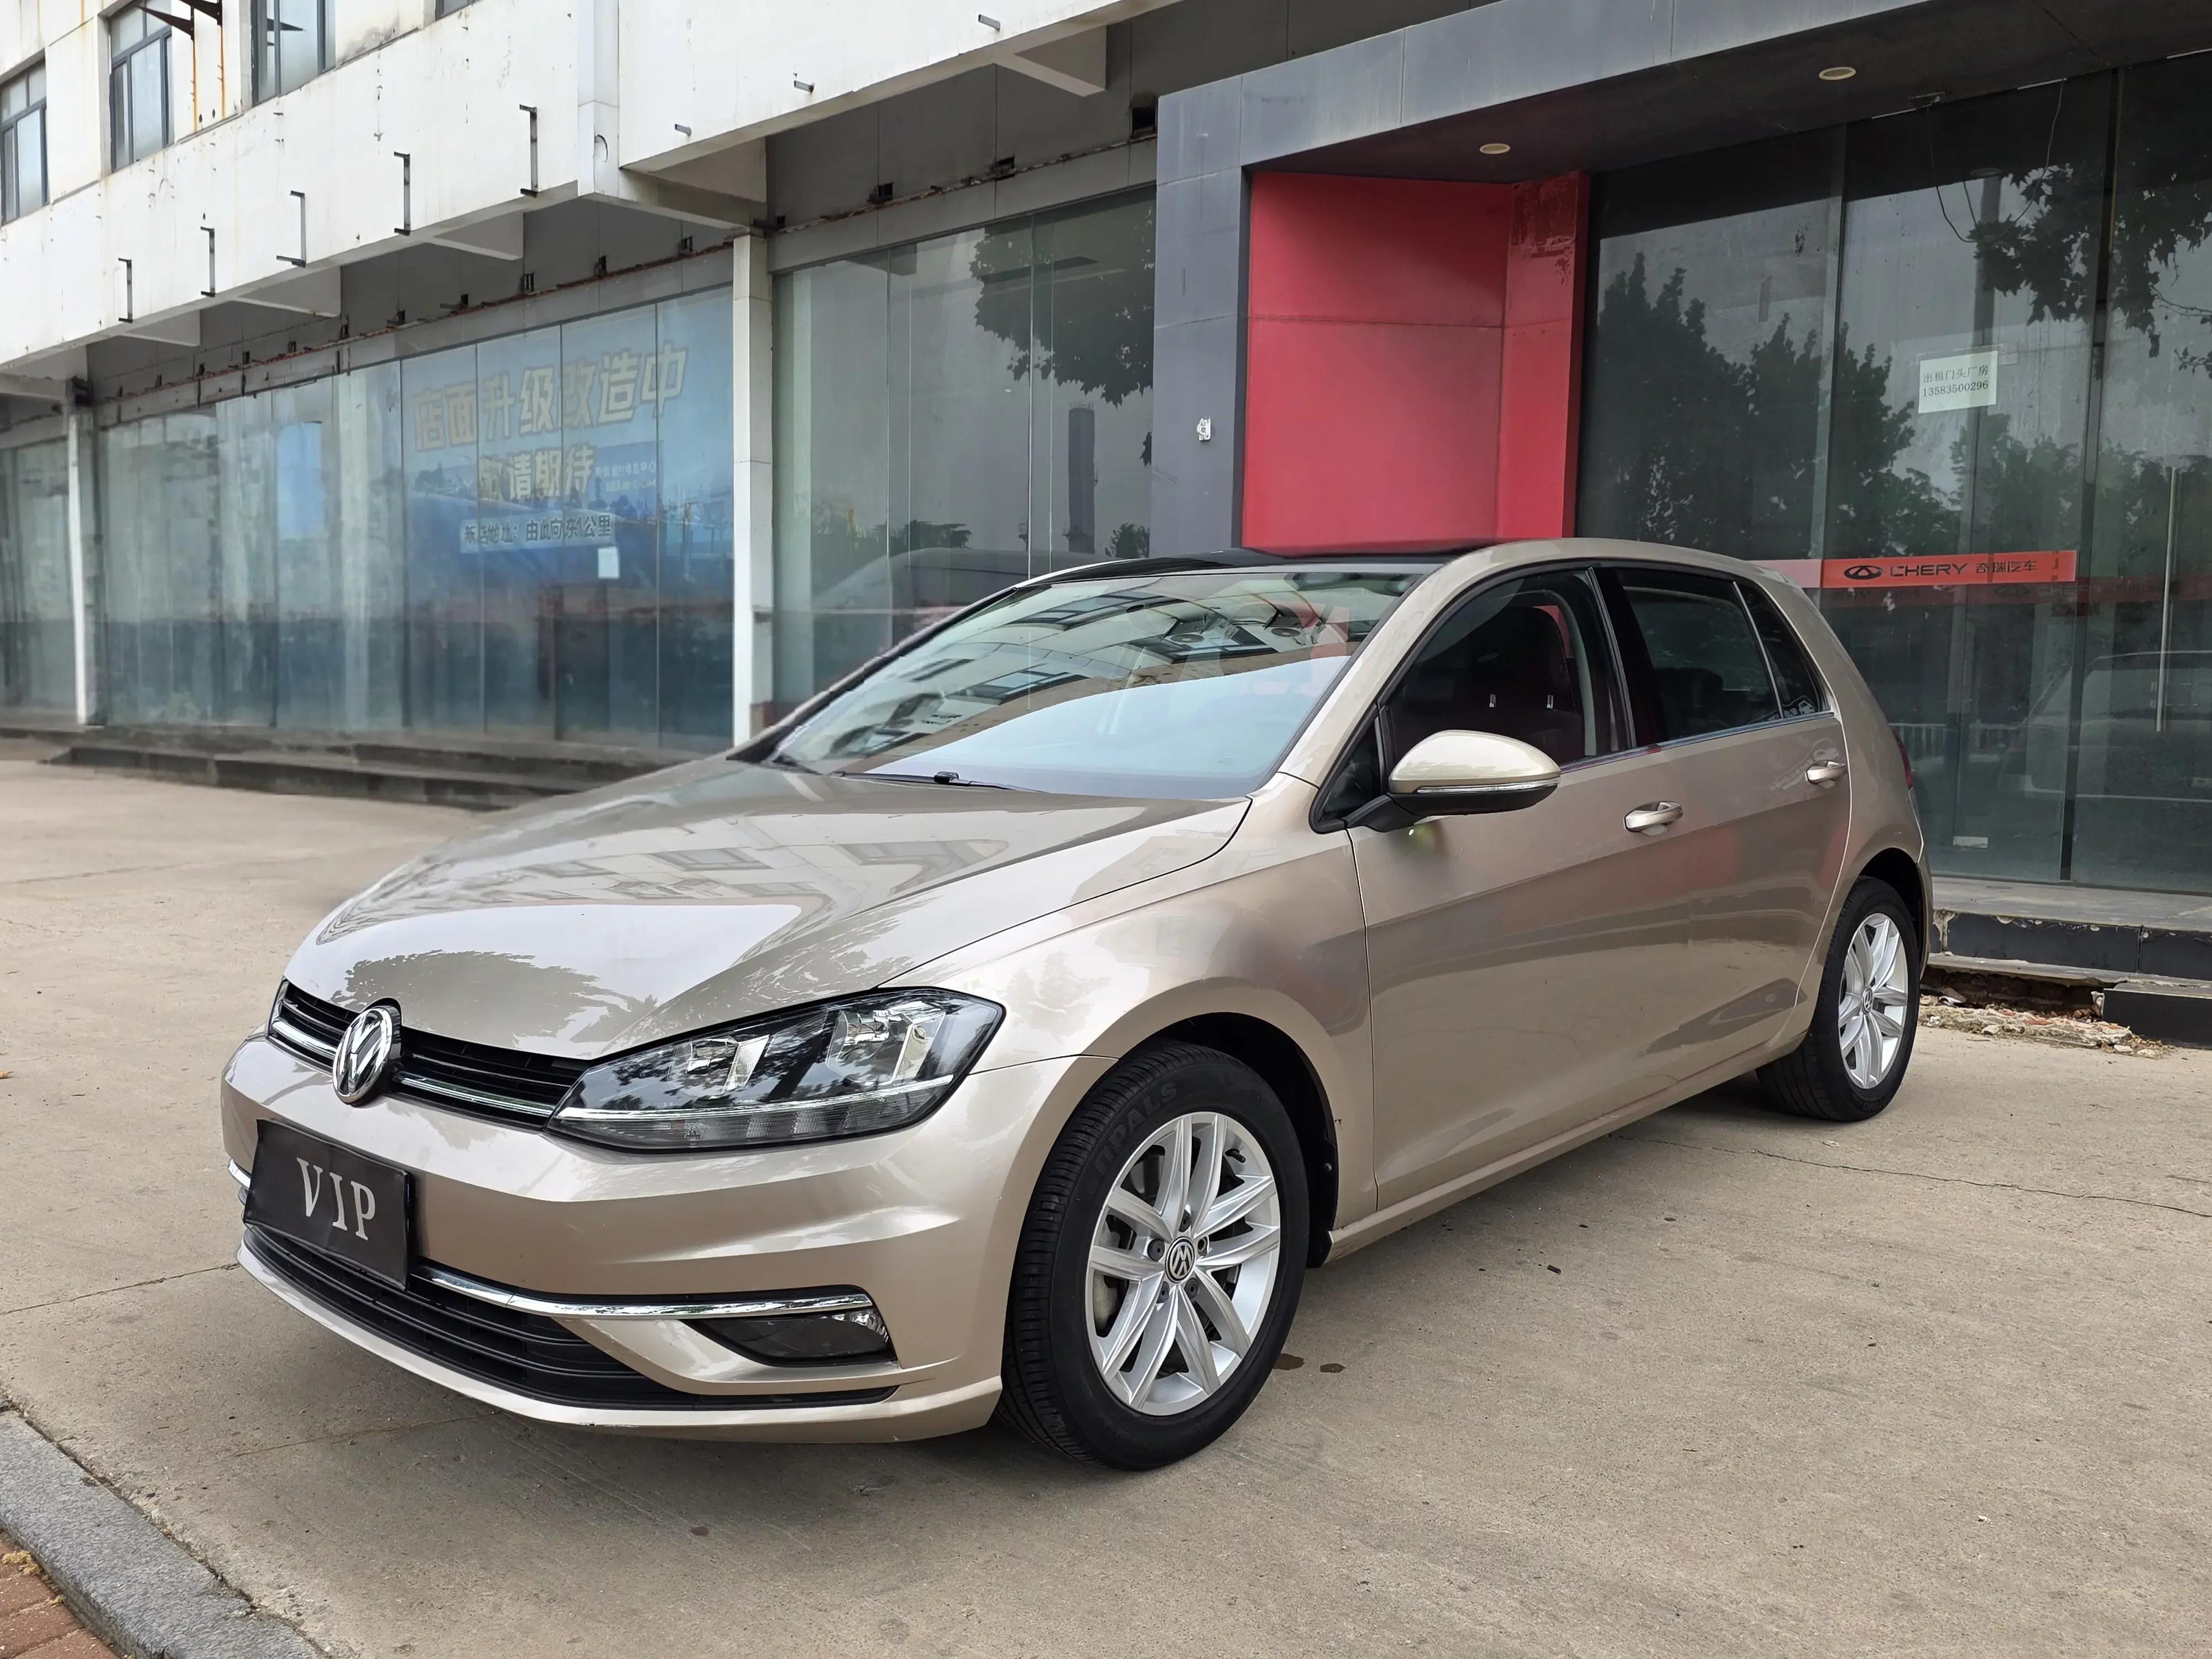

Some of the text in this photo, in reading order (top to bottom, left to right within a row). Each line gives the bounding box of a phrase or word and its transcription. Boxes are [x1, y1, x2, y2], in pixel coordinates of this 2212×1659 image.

[1923, 365, 1989, 383] 出租门头厂房
[413, 341, 688, 452] 店面升级改造中
[1923, 380, 1989, 397] 13583500296
[1890, 560, 2037, 577] CHERY 奇瑞汽车
[296, 1156, 377, 1241] VIP
